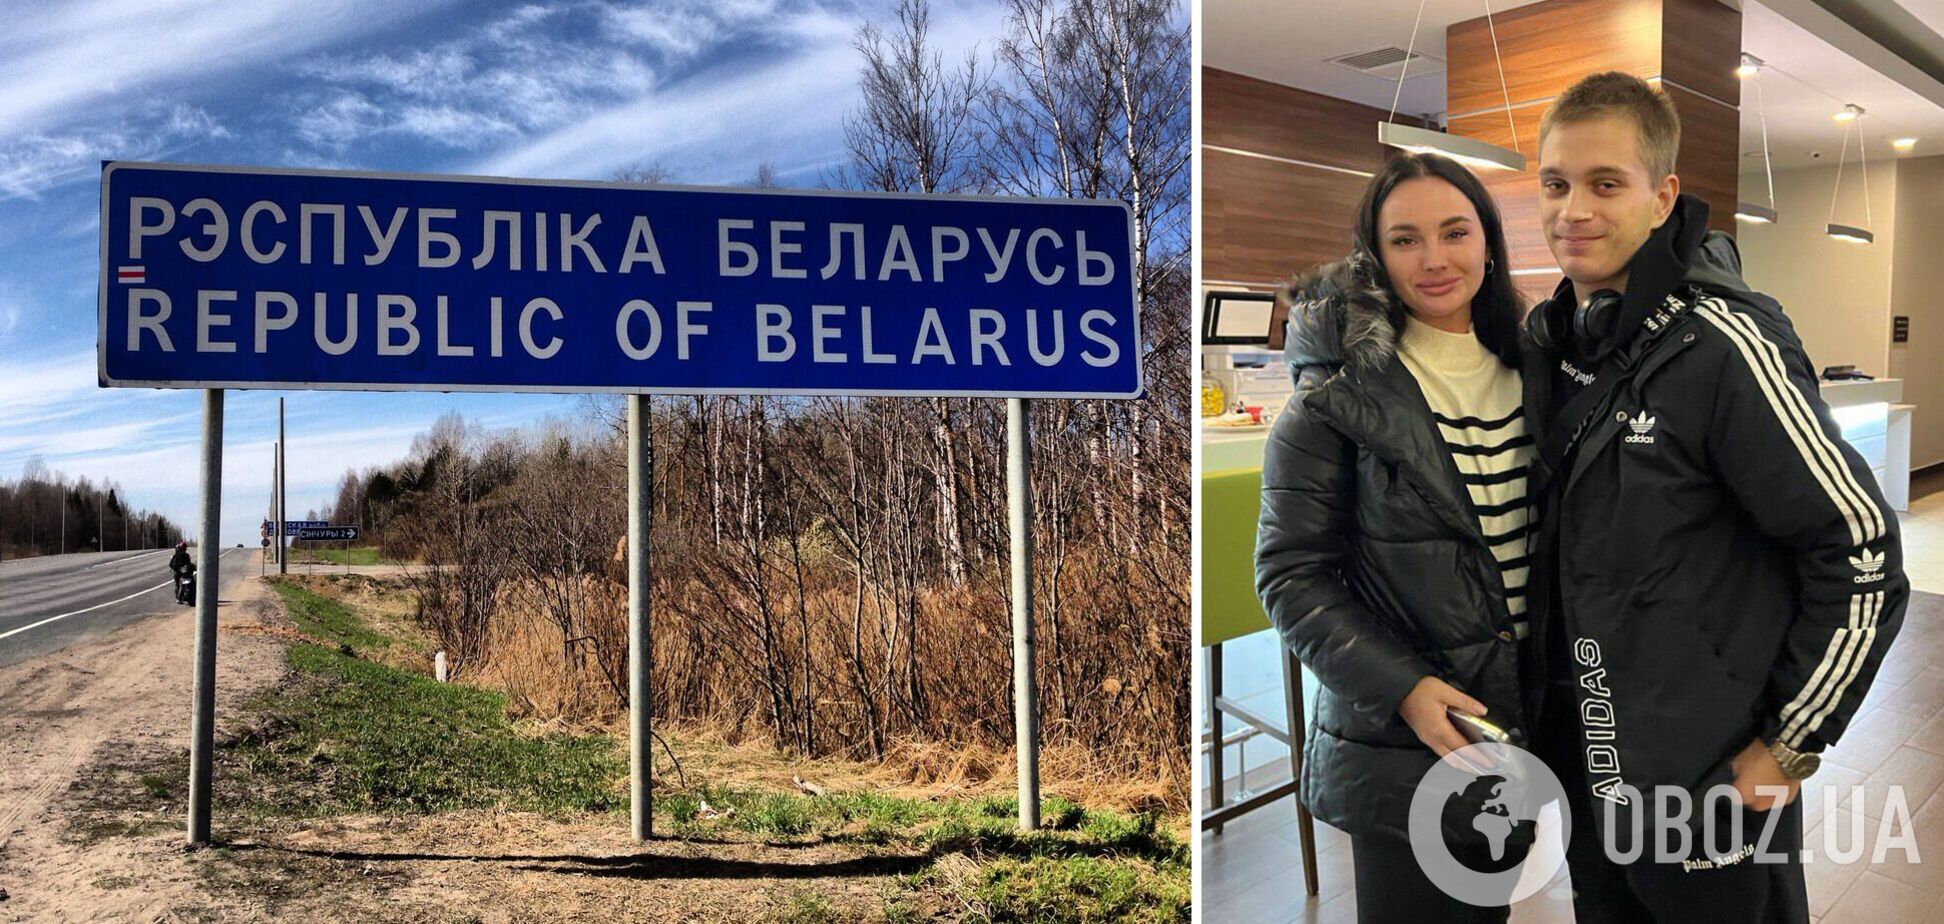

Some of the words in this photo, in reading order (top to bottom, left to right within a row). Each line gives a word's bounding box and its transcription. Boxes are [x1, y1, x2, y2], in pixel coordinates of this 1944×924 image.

[129, 196, 667, 275] РЭСПУБЛІКА
[718, 218, 1116, 287] БЕЛАРУСЬ
[126, 287, 564, 361] REPUBLIC
[615, 299, 713, 361] OF
[755, 303, 1121, 368] BELARUS
[1625, 434, 1655, 444] adidas
[1854, 572, 1885, 584] adidas
[1574, 637, 1629, 806] ADIDAS
[1682, 858, 1713, 873] Palm
[1714, 843, 1755, 869] Angels
